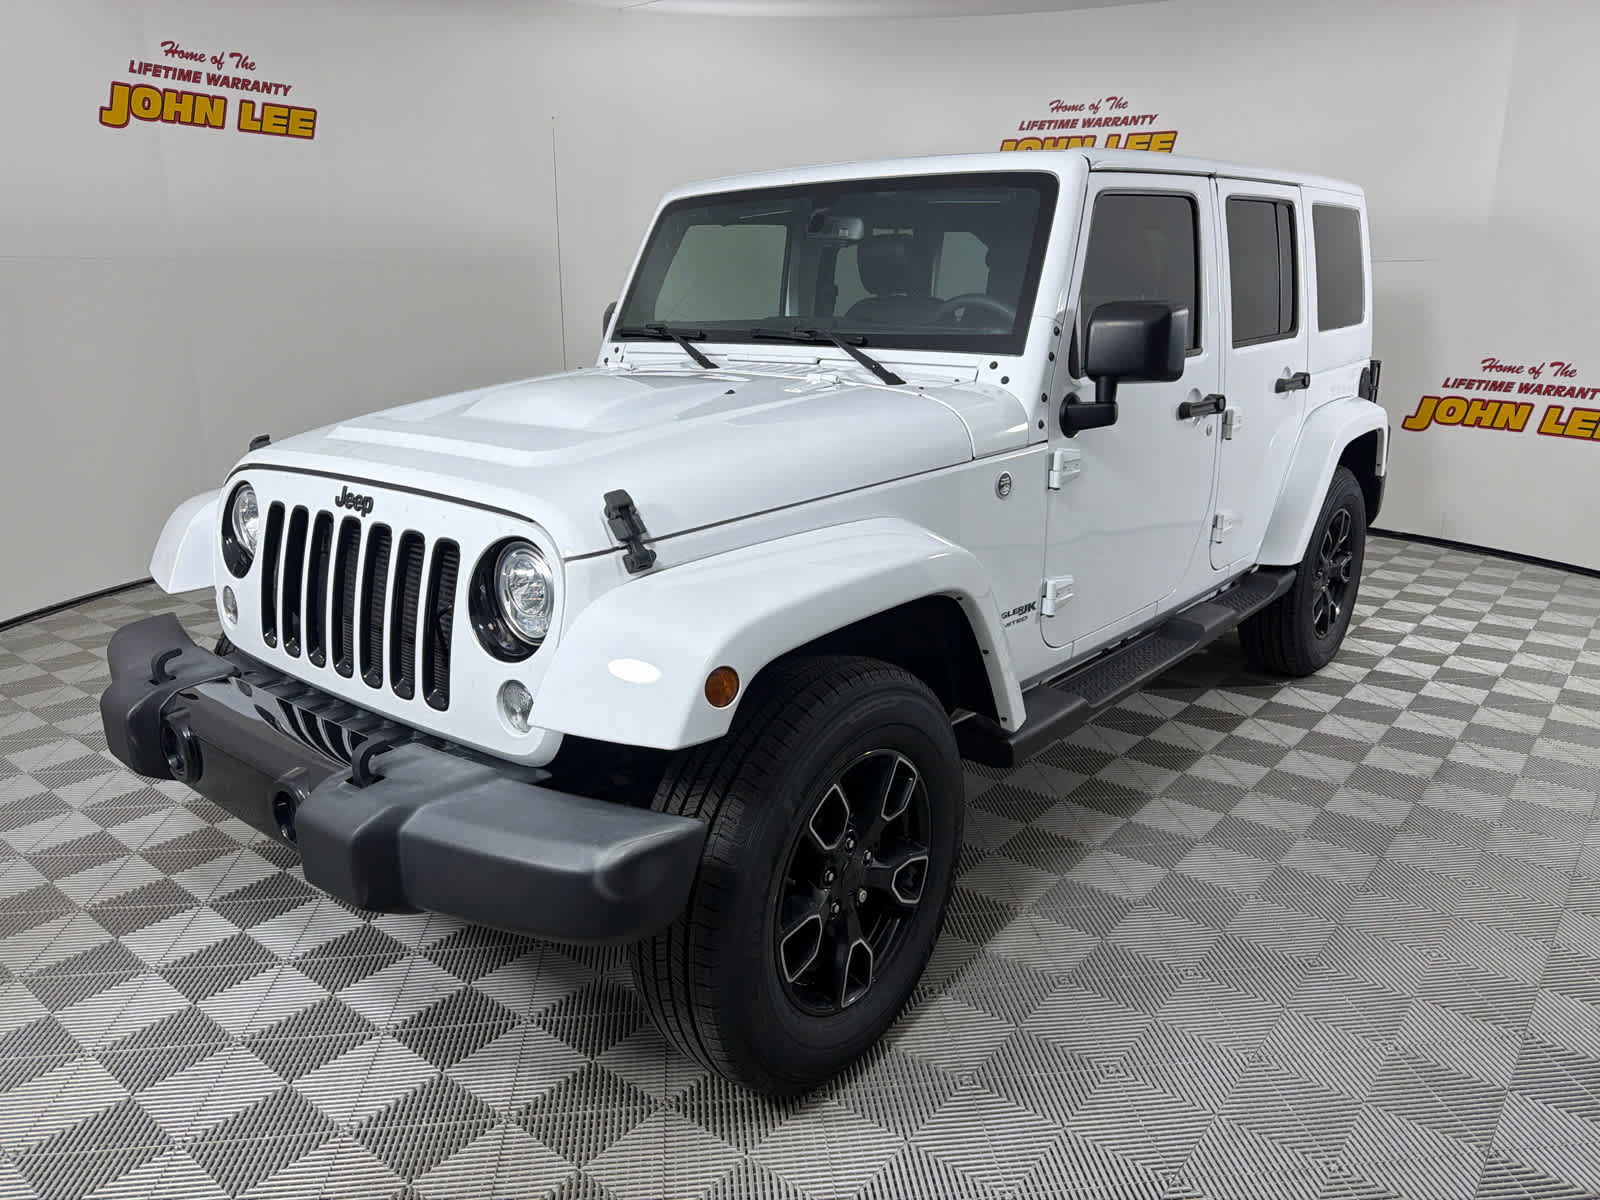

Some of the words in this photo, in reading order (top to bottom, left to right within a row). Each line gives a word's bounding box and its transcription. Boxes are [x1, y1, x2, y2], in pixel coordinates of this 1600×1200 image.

[161, 41, 206, 62] Home
[210, 52, 224, 70] of
[229, 52, 256, 71] The
[128, 60, 202, 84] LIFETIME
[206, 72, 292, 96] WARRANTY
[99, 81, 227, 129] JOHN
[237, 99, 317, 140] LEE
[1049, 99, 1085, 113] Home
[1088, 98, 1101, 114] of
[1106, 96, 1128, 111] The
[1018, 118, 1079, 131] LIFETIME
[1082, 114, 1159, 129] WARRANTY
[1481, 358, 1524, 375] Home
[1528, 362, 1545, 380] of
[1549, 362, 1577, 378] The
[1442, 377, 1515, 393] LIFETIME
[1517, 382, 1600, 400] WARRANT
[1401, 395, 1535, 432] JOHN
[335, 485, 374, 518] Jeep
